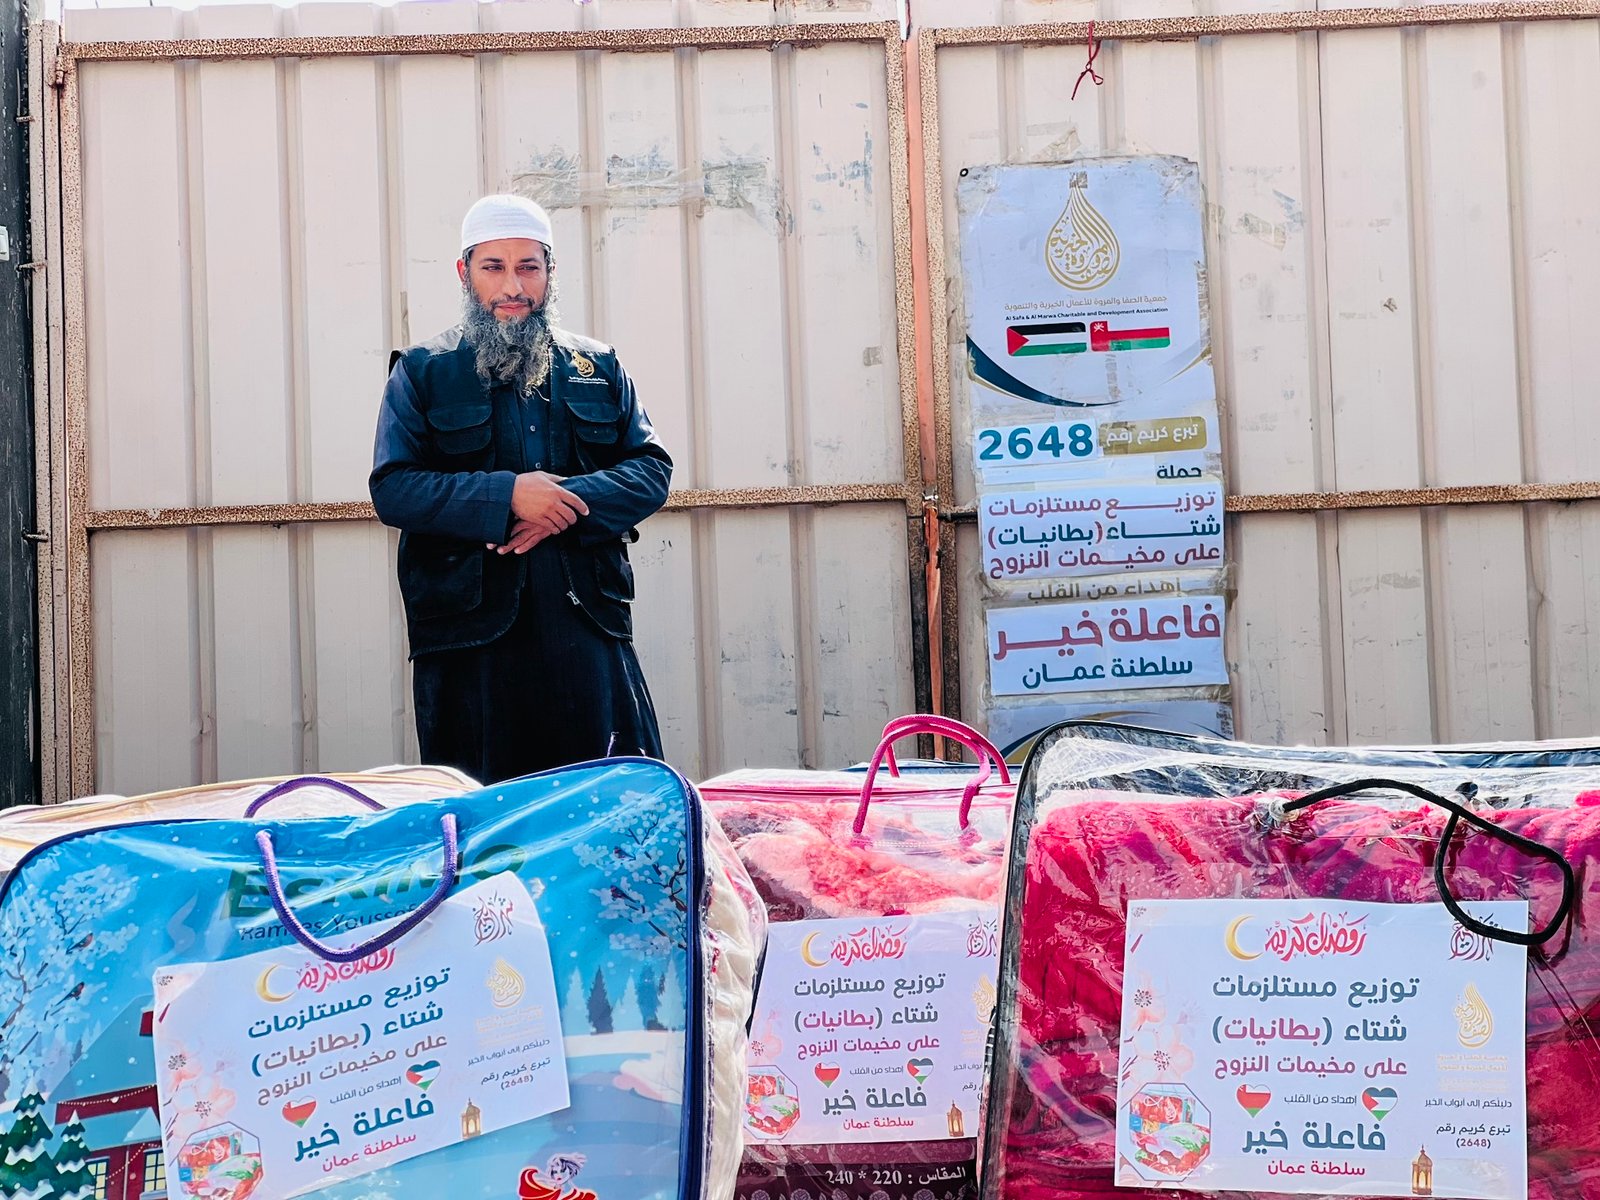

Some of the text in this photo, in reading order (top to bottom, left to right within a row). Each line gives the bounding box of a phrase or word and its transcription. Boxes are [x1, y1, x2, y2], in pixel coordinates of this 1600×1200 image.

[1098, 308, 1135, 316] Development
[978, 423, 1093, 461] 2648
[1137, 426, 1169, 445] كريم
[1173, 423, 1199, 443] تبرع
[1156, 464, 1202, 479] حملة
[989, 491, 1216, 519] توزيع مستلزمات
[990, 543, 1221, 579] على مخيمات النزوح
[1028, 582, 1080, 604] القلب
[1087, 583, 1118, 600] من
[993, 603, 1221, 661] فاعلة خير
[1022, 656, 1193, 689] سلطنة عمان
[241, 921, 322, 940] Rames
[384, 966, 451, 1008] توزيع
[794, 972, 946, 998] توزيع مستلزمات
[1213, 976, 1420, 1008] توزيع مستلزمات
[248, 994, 373, 1039] مستلزمات
[383, 1001, 444, 1036] شتاء
[794, 1002, 938, 1033] شتاء (بطانيات)
[1213, 1015, 1407, 1046] شتاء (بطانيات)
[252, 1022, 372, 1077] (بطانيات)
[797, 1039, 838, 1061] النزوح
[843, 1038, 900, 1055] مخيمات
[907, 1035, 940, 1052] على
[257, 1034, 447, 1107] على مخيمات النزوح
[481, 1057, 551, 1085] تبرع كريم رقم
[1215, 1056, 1407, 1080] على مخيمات النزوح
[358, 1085, 374, 1097] من
[500, 1074, 534, 1090] (2648)
[962, 1082, 977, 1091] رقم
[822, 1086, 927, 1115] فاعلة خير
[1284, 1094, 1311, 1105] القلب
[1313, 1094, 1329, 1105] من
[294, 1092, 434, 1162] فاعلة خير
[843, 1116, 914, 1130] سلطنة عمان
[1436, 1123, 1511, 1136] تبرع كريم رقم
[1242, 1121, 1386, 1155] فاعلة خير
[1456, 1138, 1491, 1149] (2648)
[322, 1132, 417, 1172] سلطنة عمان
[825, 1170, 853, 1185] 240
[872, 1170, 902, 1185] 220
[918, 1166, 966, 1185] المقاس
[1267, 1160, 1366, 1175] سلطنة عمان
